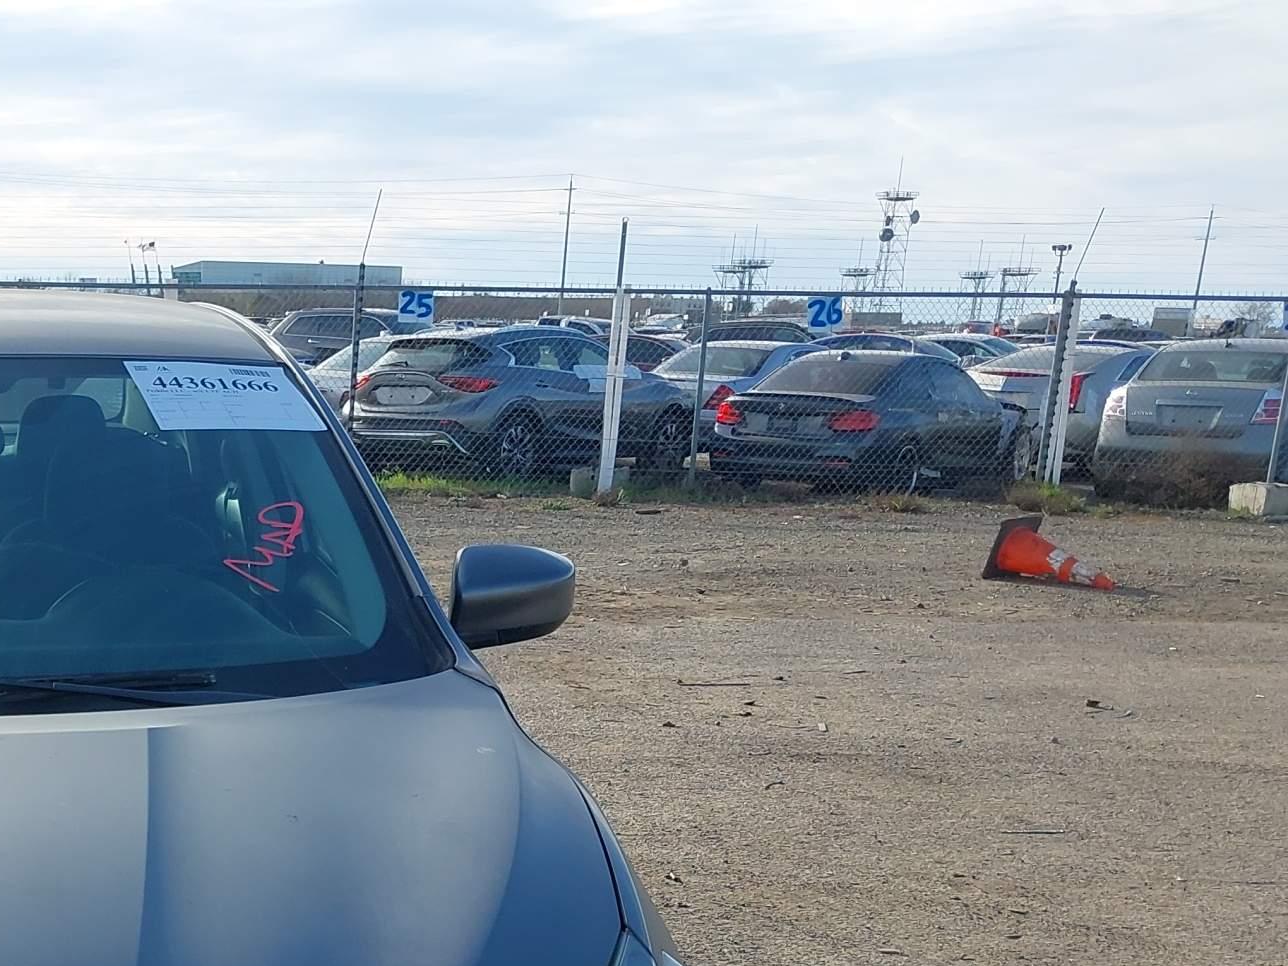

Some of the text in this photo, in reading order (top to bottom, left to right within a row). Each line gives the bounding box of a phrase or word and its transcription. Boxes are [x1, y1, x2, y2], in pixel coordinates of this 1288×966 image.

[400, 290, 433, 318] 25
[808, 296, 842, 327] 26
[152, 376, 279, 392] 44361666
